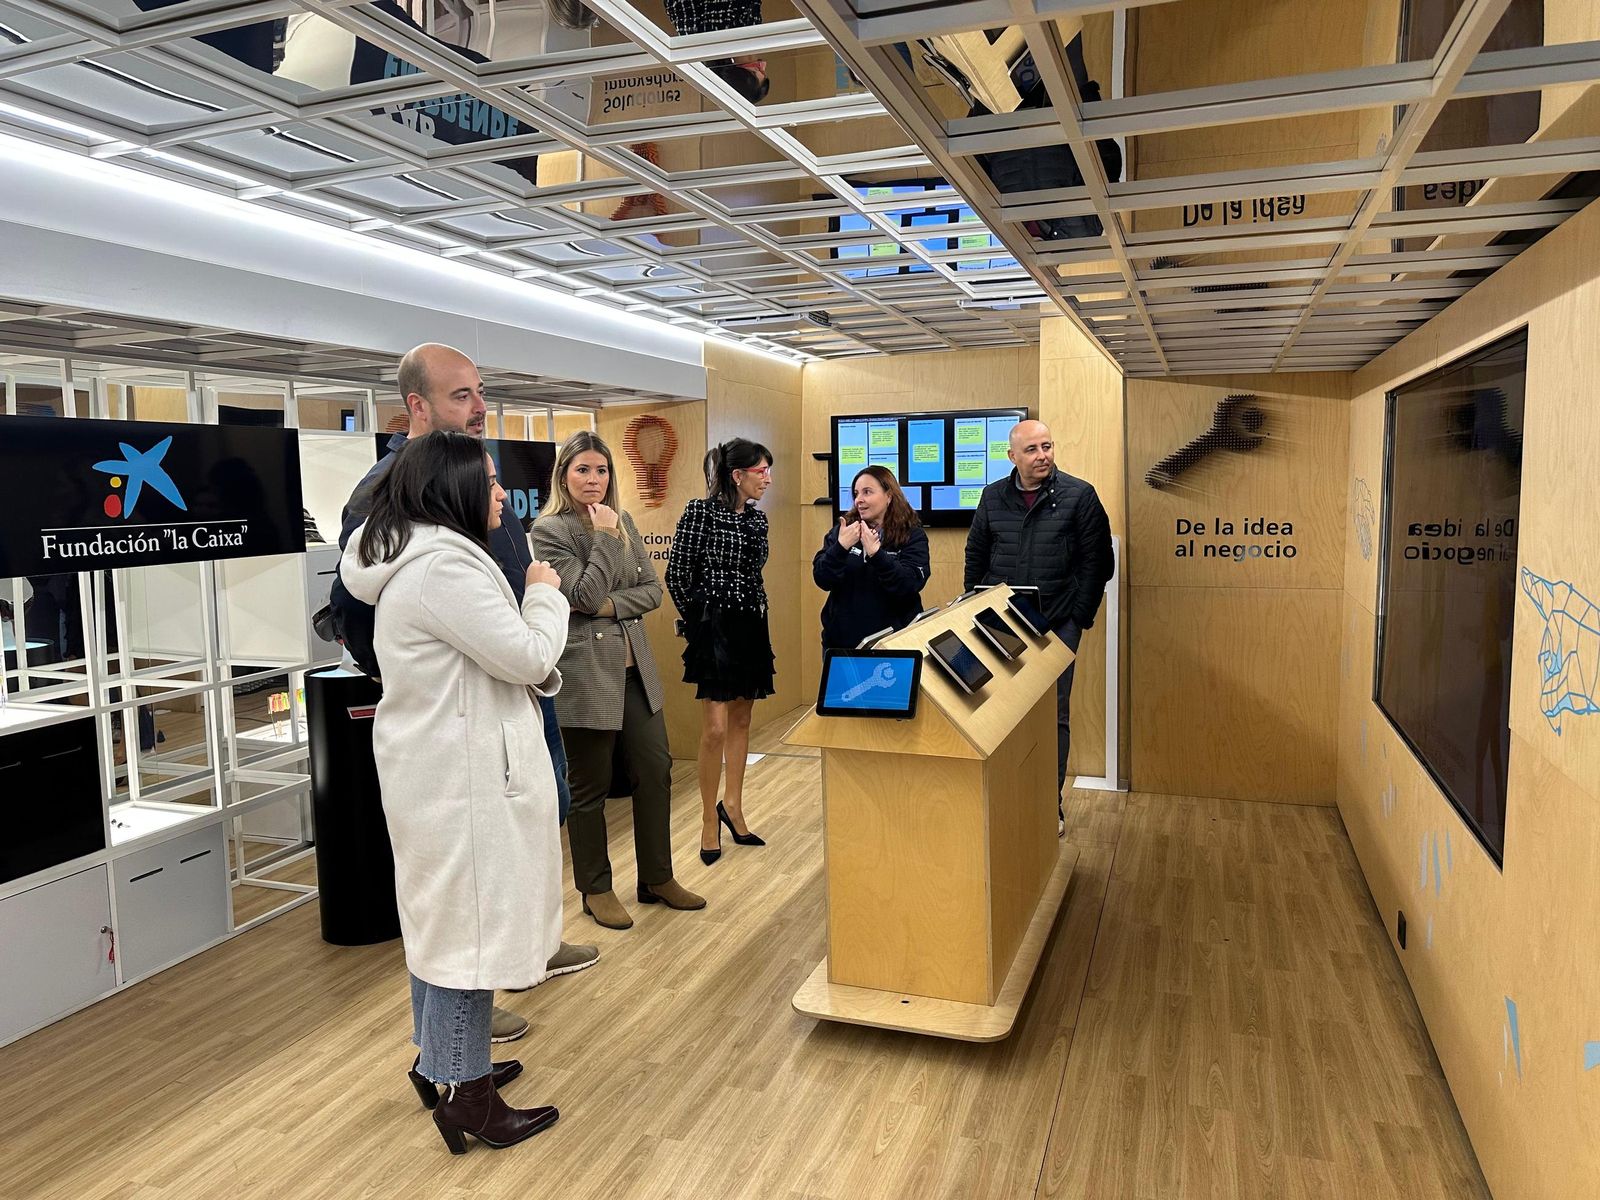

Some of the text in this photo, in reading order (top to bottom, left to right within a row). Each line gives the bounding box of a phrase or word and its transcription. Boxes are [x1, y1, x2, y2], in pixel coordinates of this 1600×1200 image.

[1176, 517, 1293, 535] De la idea
[41, 532, 160, 559] Fundación
[1175, 539, 1297, 562] al negocio
